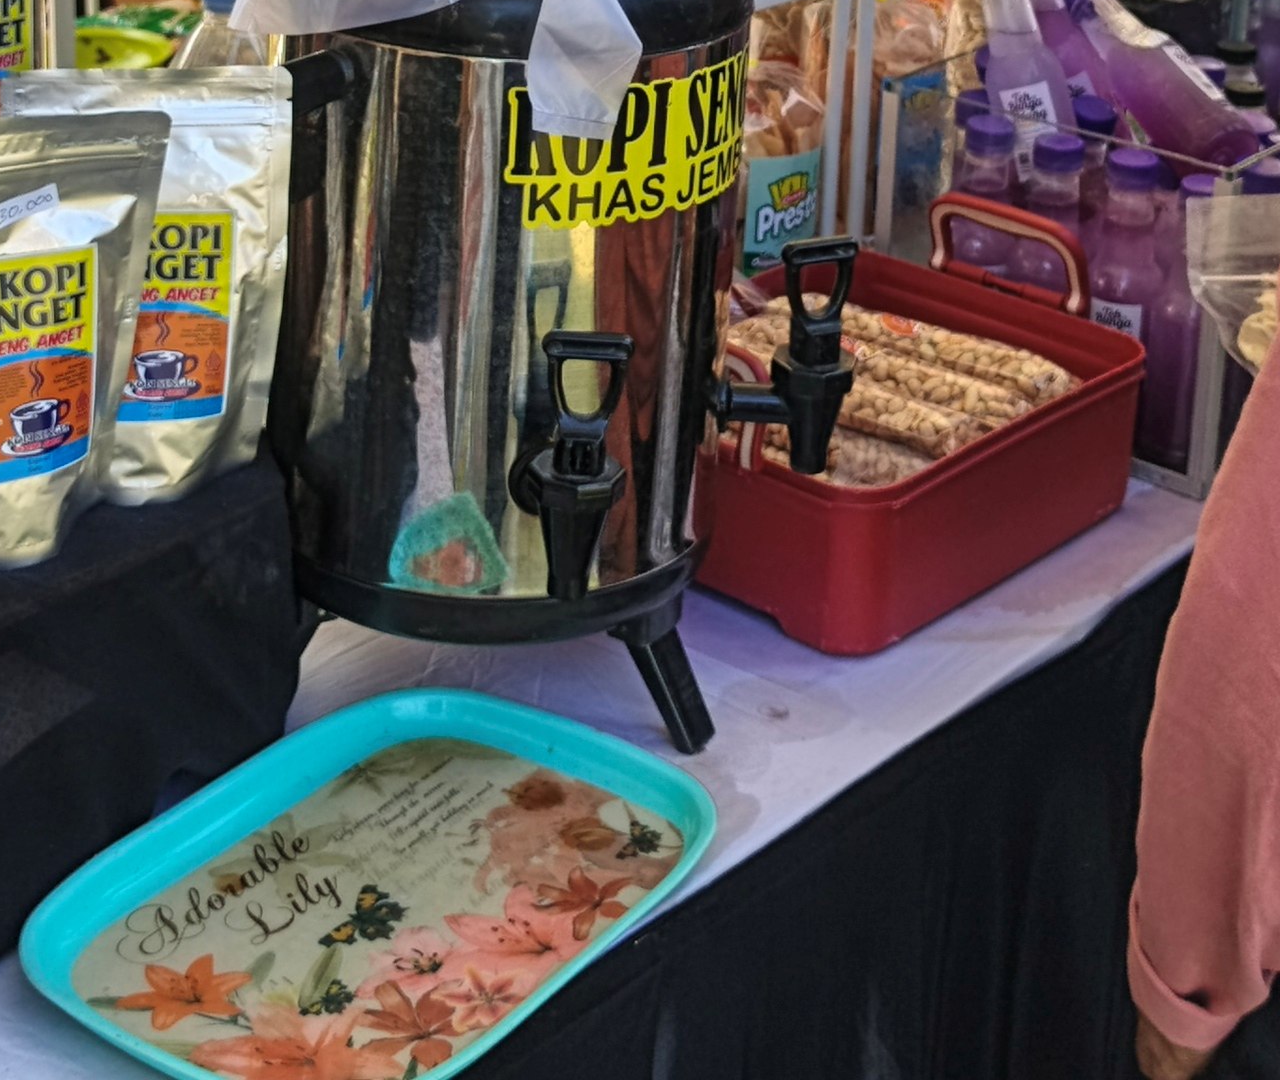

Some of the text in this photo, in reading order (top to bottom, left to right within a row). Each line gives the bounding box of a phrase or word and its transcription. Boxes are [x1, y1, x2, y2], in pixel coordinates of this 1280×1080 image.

[528, 172, 665, 221] KHAS
[165, 286, 221, 302] ANGET
[36, 324, 86, 349] ANGET
[116, 830, 311, 965] Adorable
[223, 872, 343, 945] Lily
